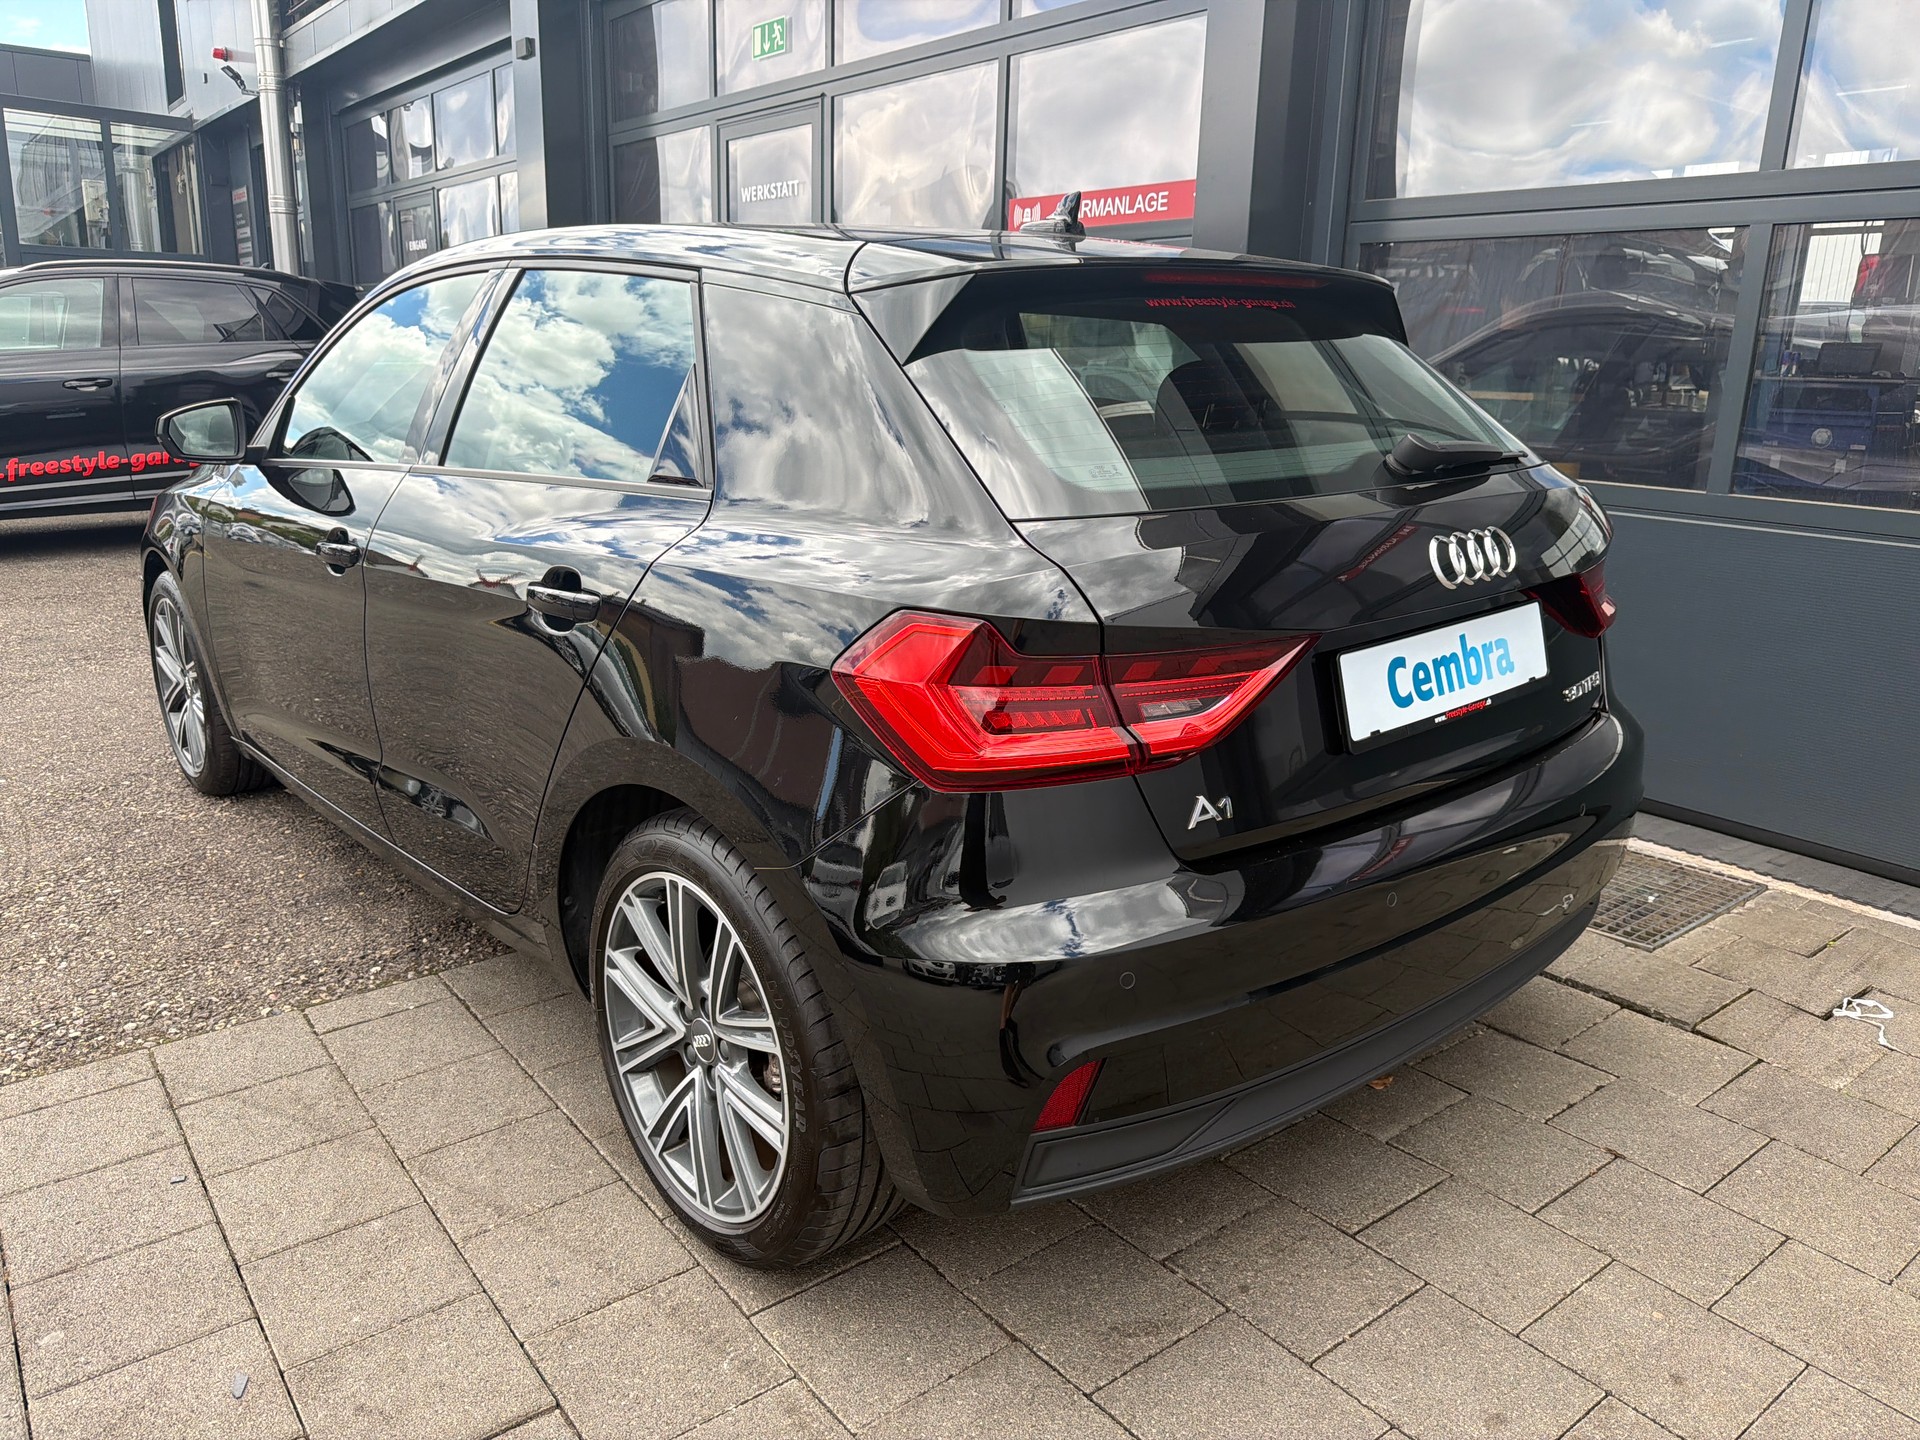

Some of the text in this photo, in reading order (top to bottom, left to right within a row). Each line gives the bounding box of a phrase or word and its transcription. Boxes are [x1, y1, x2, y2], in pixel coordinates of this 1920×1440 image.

[741, 180, 799, 203] WERKSTATT
[1078, 191, 1169, 219] RMANLAGE
[1145, 296, 1296, 310] www.freestyle-garage.ch
[0, 451, 201, 482] .freestyle-gar
[1387, 633, 1515, 709] Cembra
[1188, 795, 1233, 830] A1
